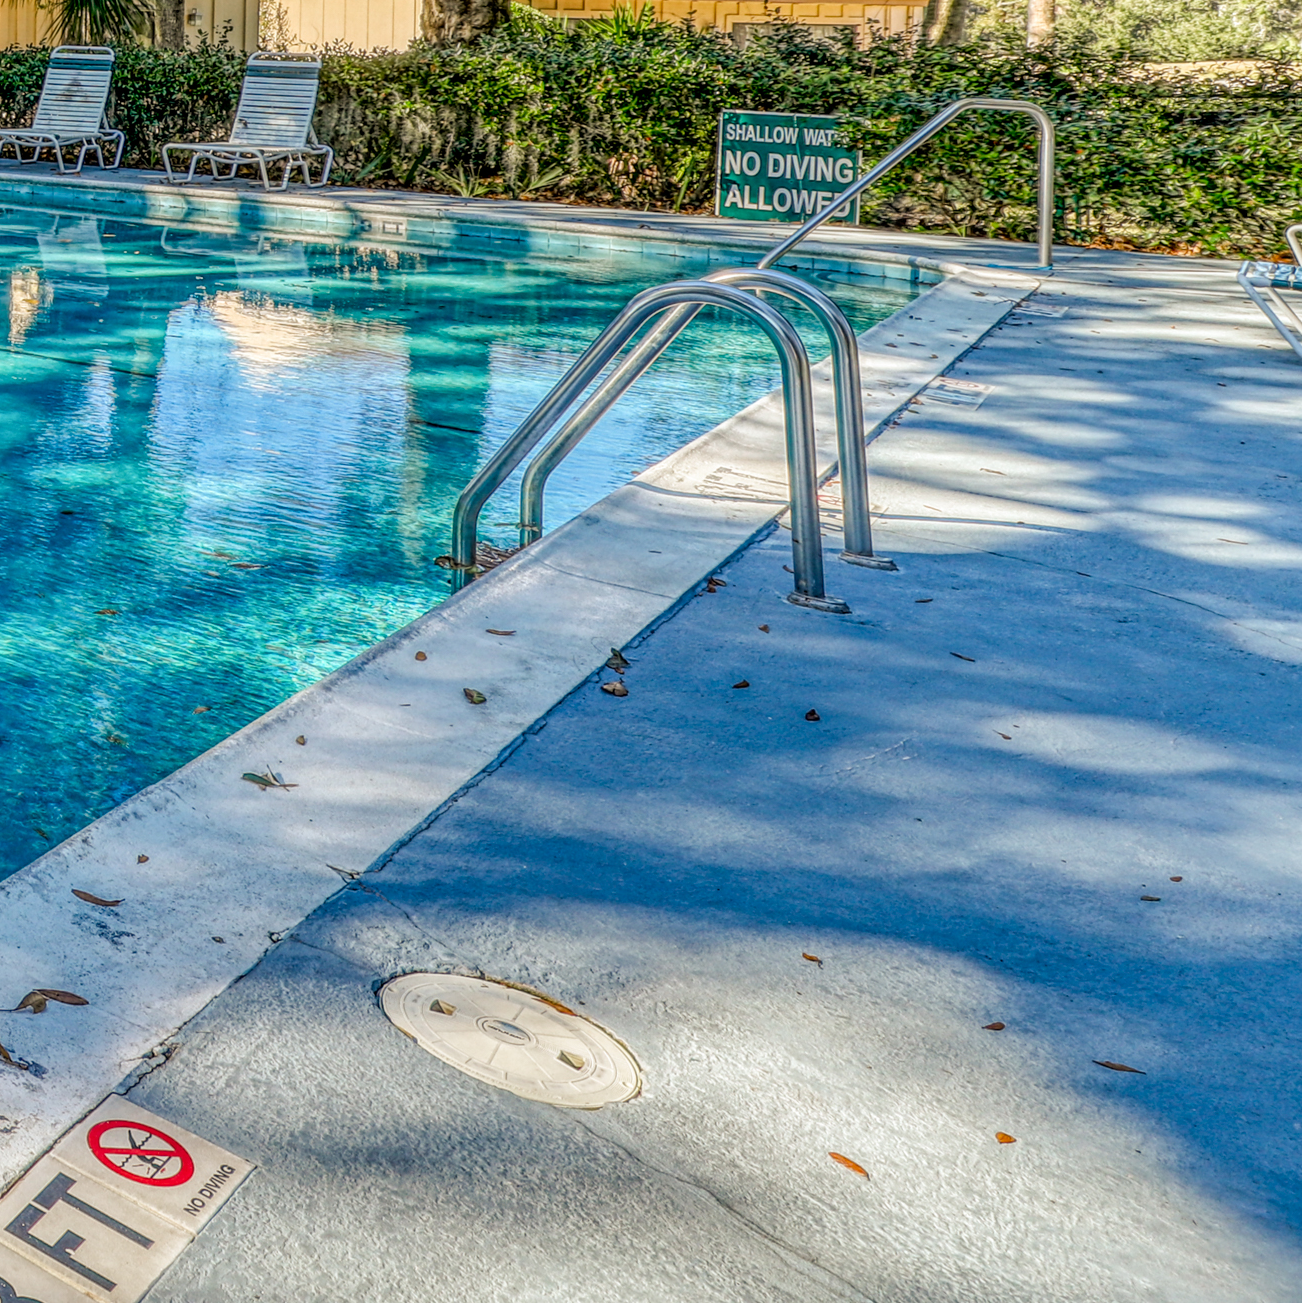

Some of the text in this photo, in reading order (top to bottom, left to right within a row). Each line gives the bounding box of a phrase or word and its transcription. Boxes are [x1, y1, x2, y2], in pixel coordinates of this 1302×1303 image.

[725, 123, 847, 147] SHALLOW WAT
[724, 150, 854, 184] NO DIVING
[183, 1164, 236, 1217] NO DIVING
[4, 1172, 155, 1292] FT
